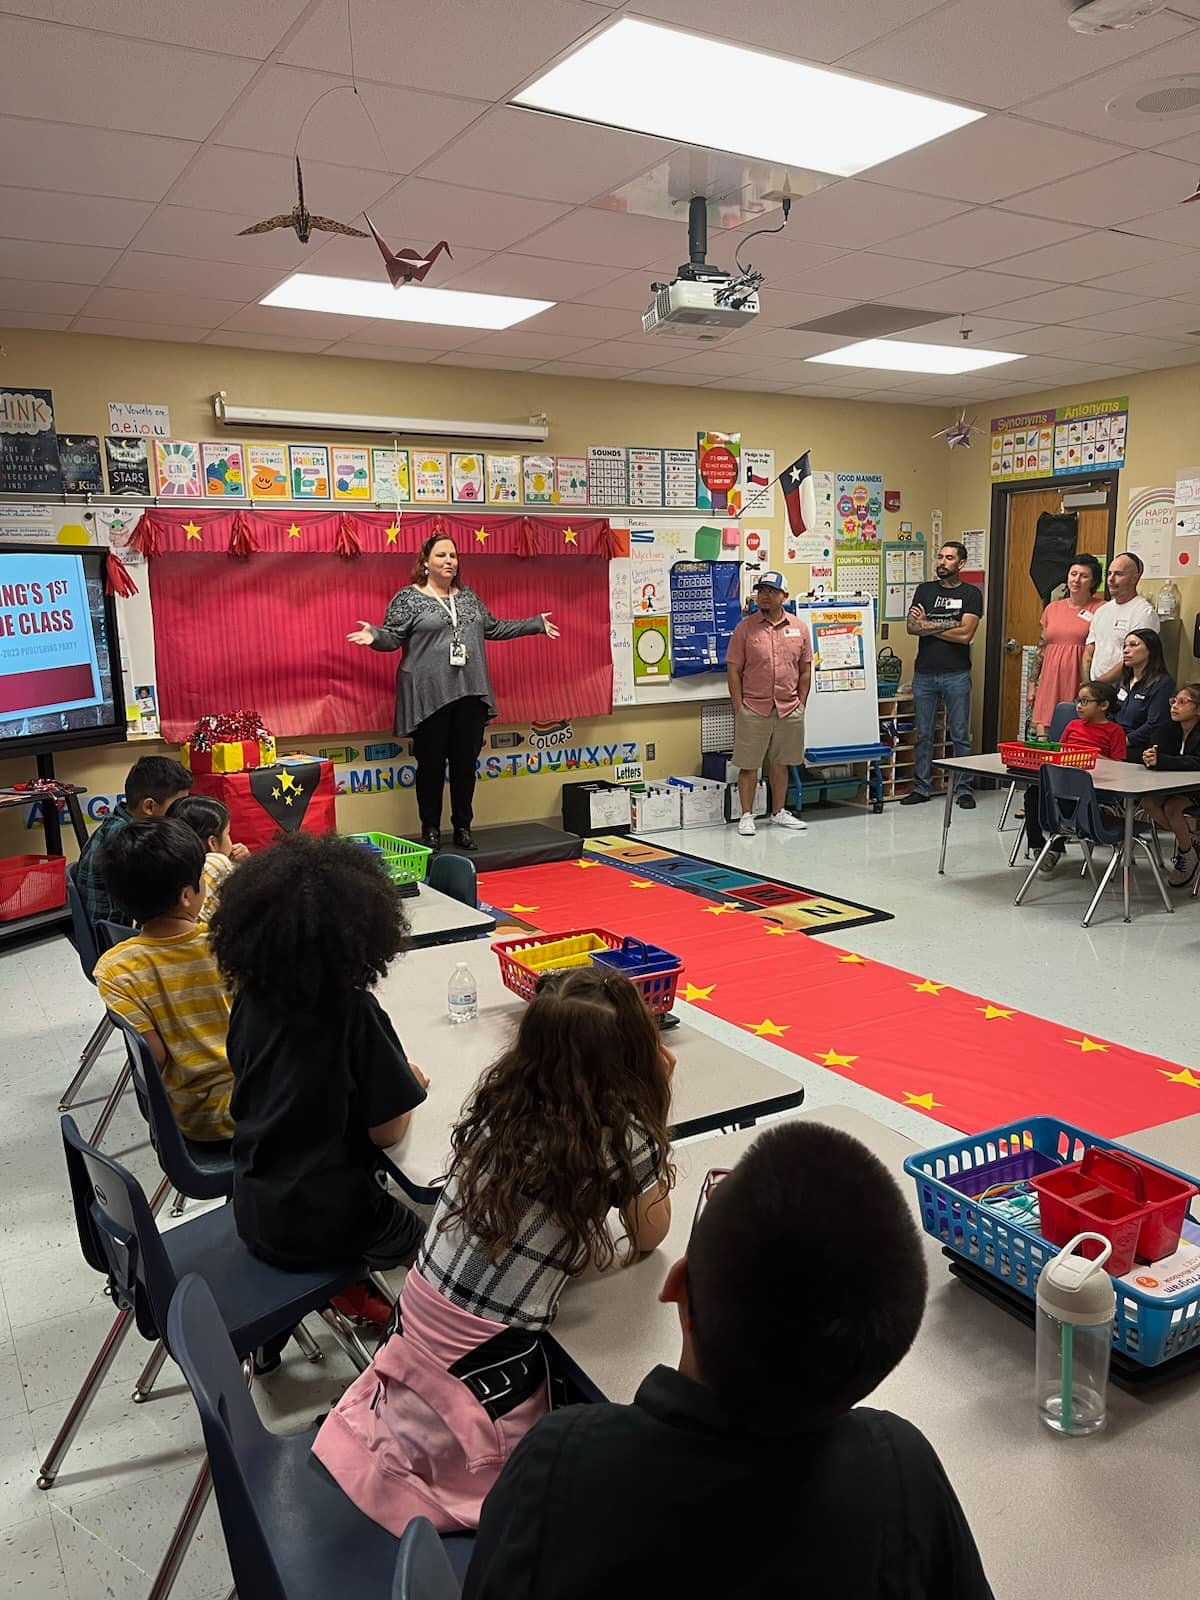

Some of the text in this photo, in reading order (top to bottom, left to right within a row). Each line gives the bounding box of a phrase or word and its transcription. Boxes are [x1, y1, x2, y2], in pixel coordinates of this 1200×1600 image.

[1065, 401, 1120, 420] Antonyms
[997, 414, 1047, 431] Synonyms
[62, 453, 97, 465] World
[592, 449, 621, 457] SOUNDS
[113, 471, 145, 483] STARS
[837, 474, 855, 482] GOOD
[1145, 508, 1173, 517] HAPPY
[811, 565, 832, 577] Numbers
[0, 580, 68, 607] NG'S 1ST
[18, 609, 74, 635] CLASS
[21, 643, 58, 656] PUBLISHING
[60, 641, 77, 651] PARTY
[529, 728, 573, 749] COLORS
[616, 766, 642, 780] Letters
[659, 860, 687, 875] K
[702, 874, 730, 885] L
[749, 888, 796, 902] M
[798, 905, 844, 919] N
